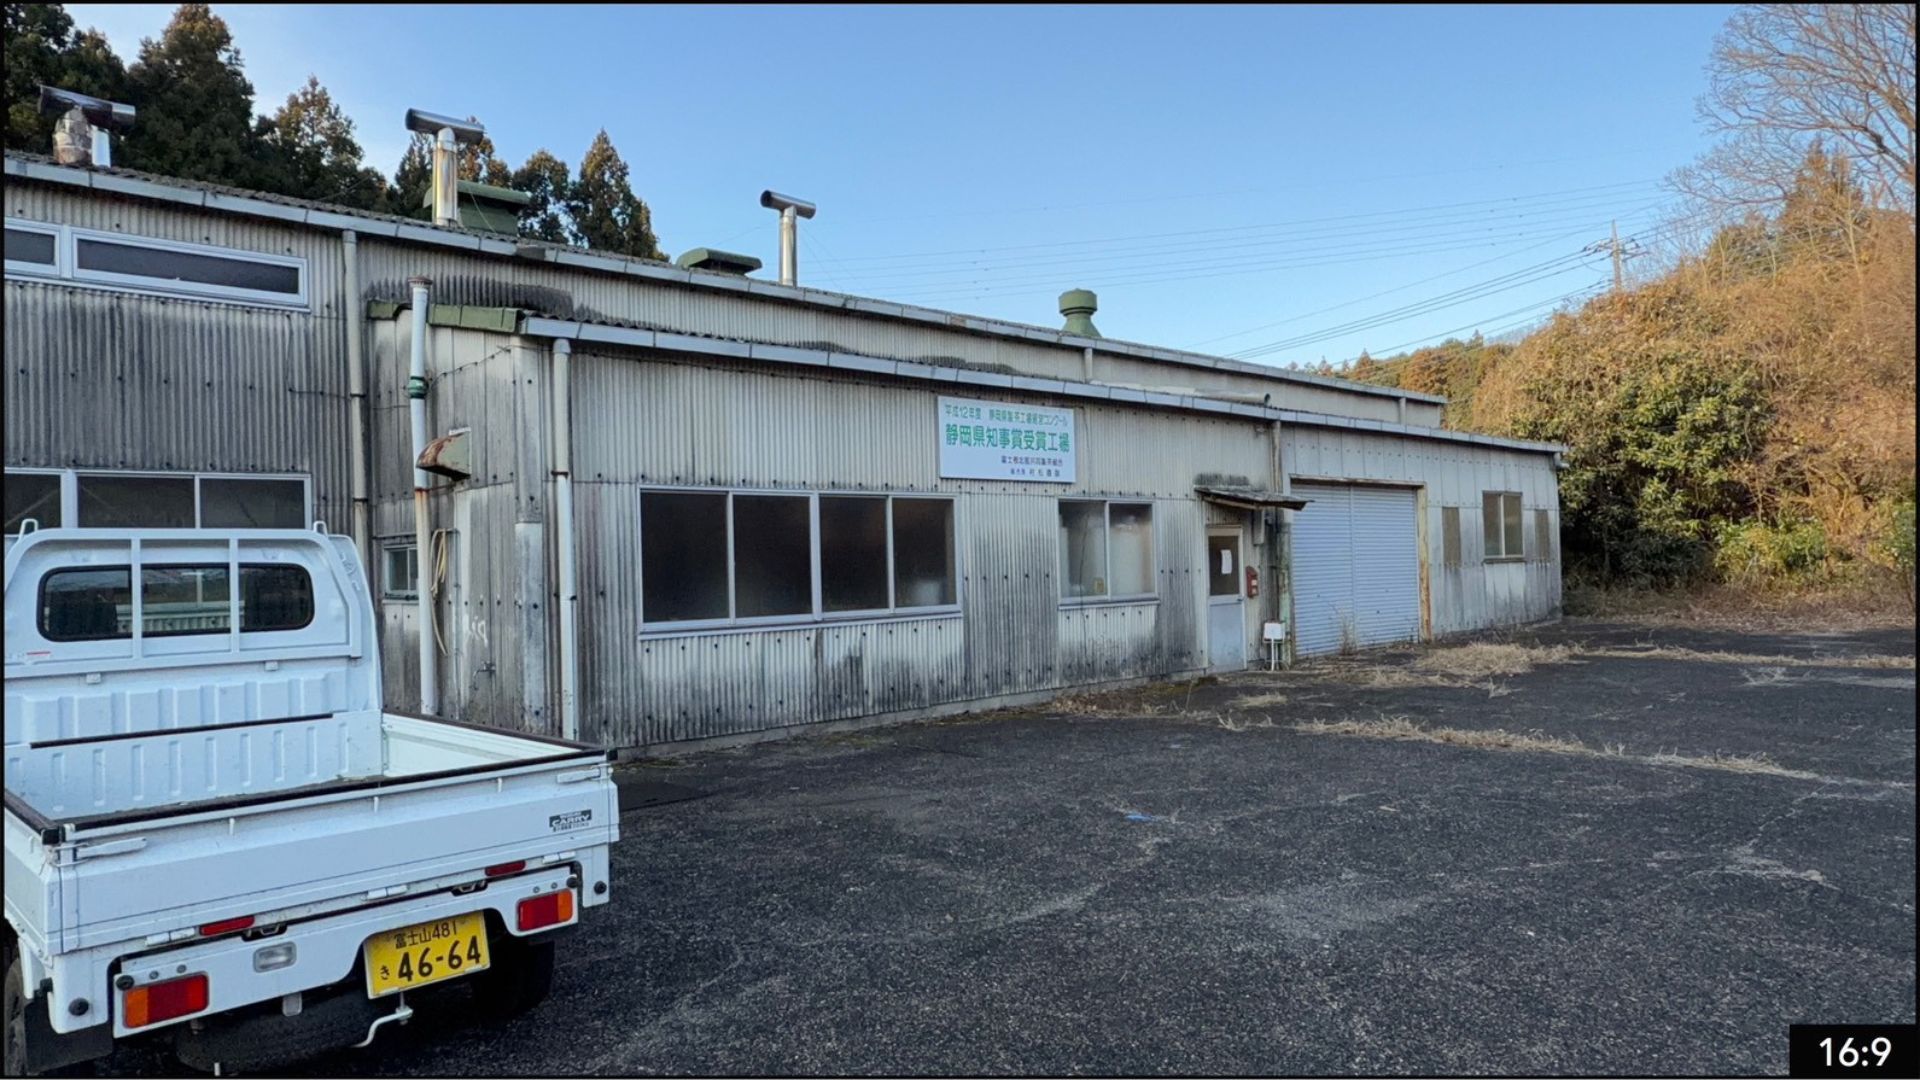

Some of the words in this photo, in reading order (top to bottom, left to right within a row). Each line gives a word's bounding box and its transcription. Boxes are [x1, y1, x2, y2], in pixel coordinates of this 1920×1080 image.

[946, 424, 1070, 453] 静岡県知事賞受賞工場
[394, 920, 457, 949] 富士山481
[380, 965, 390, 980] き
[398, 935, 481, 982] 46-64
